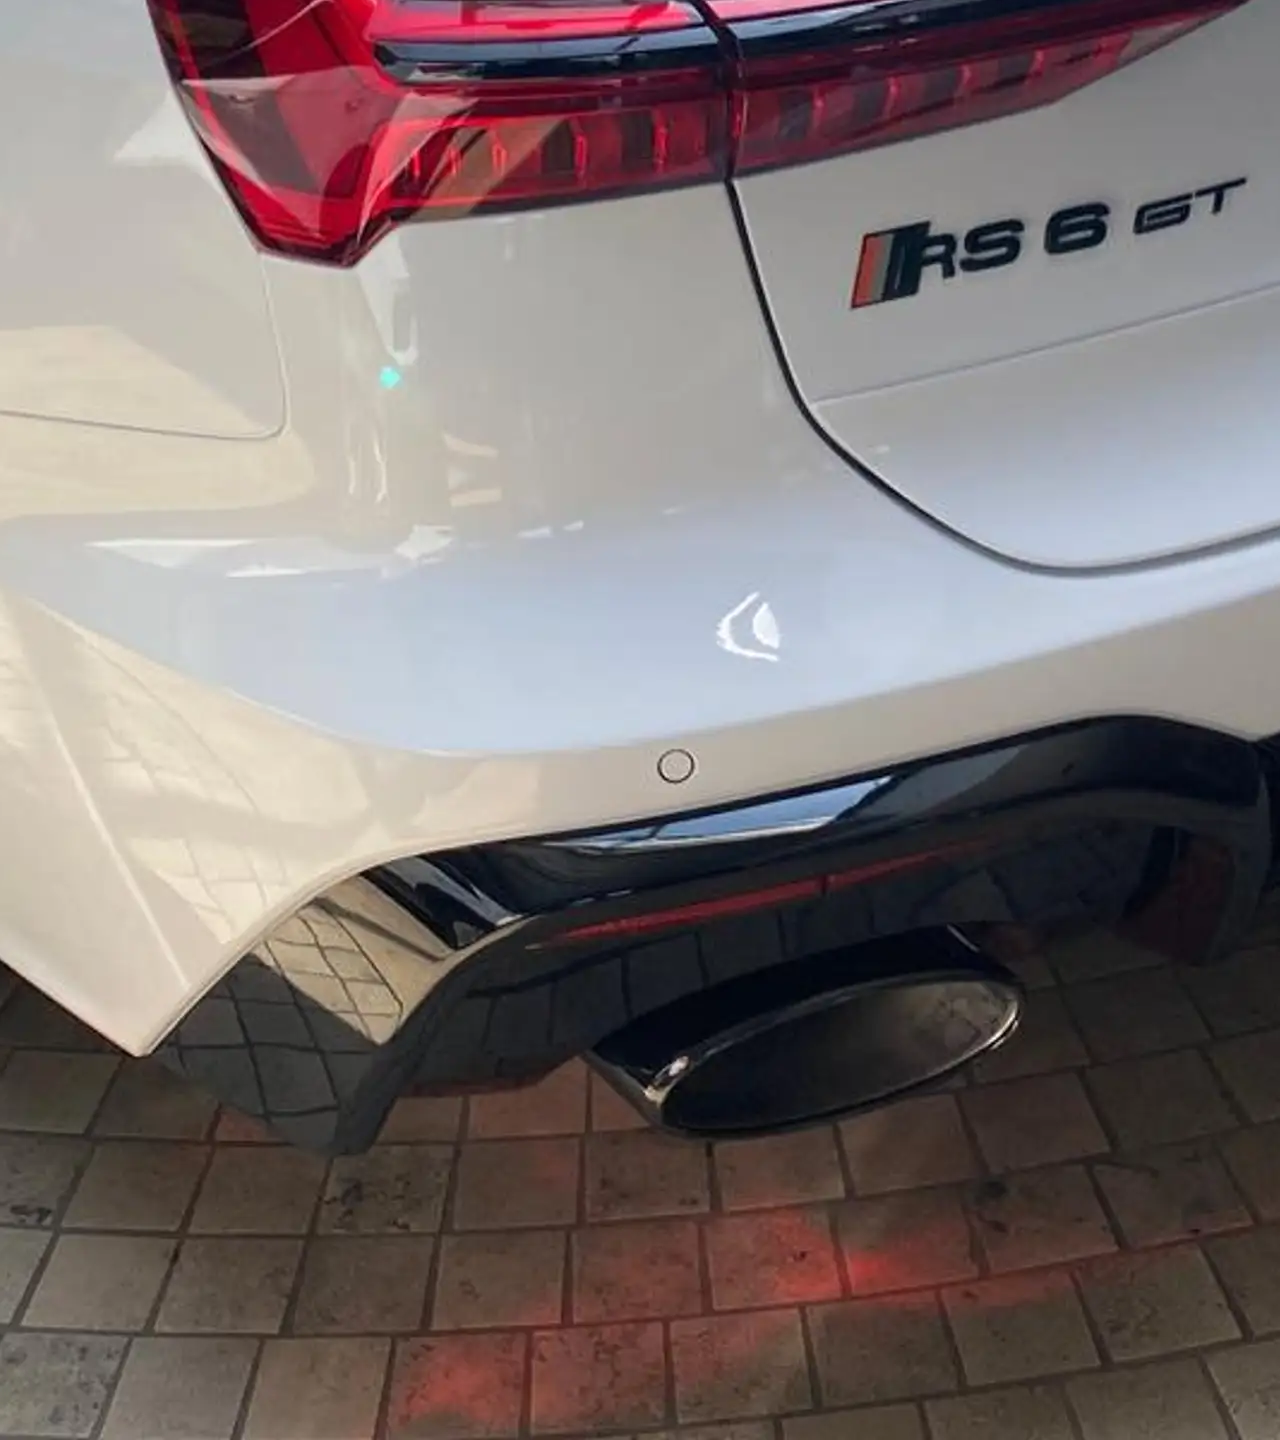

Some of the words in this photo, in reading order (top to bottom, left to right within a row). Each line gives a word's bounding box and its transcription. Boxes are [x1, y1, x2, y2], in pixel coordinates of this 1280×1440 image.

[888, 219, 1026, 296] RS
[1043, 201, 1111, 254] 6
[1132, 176, 1248, 235] GT
